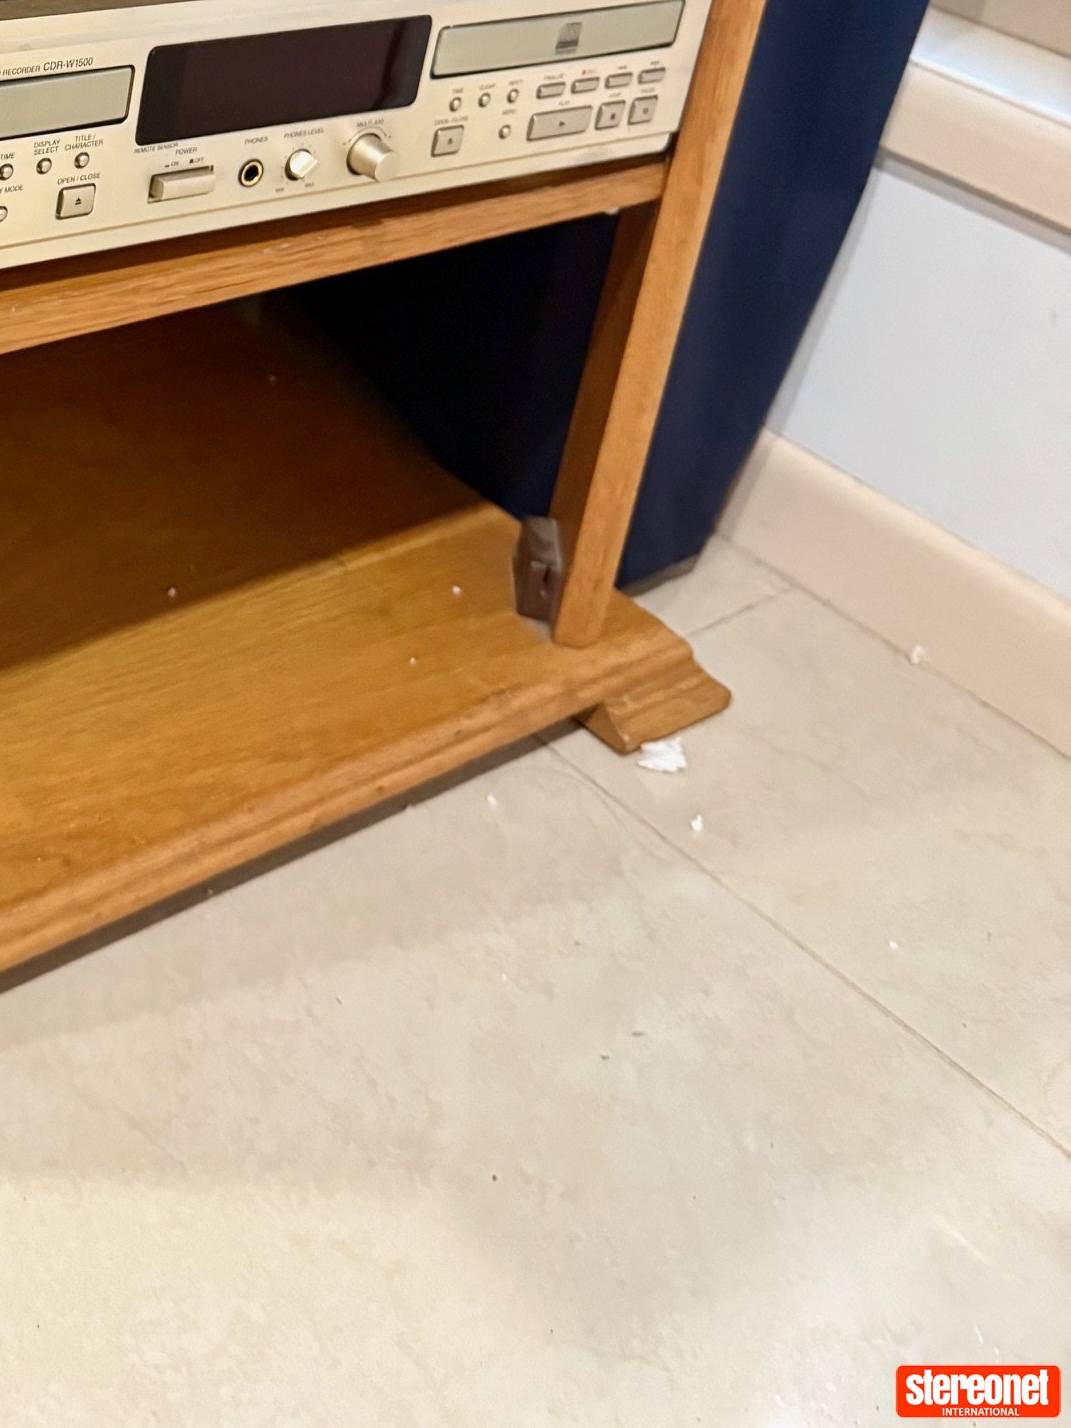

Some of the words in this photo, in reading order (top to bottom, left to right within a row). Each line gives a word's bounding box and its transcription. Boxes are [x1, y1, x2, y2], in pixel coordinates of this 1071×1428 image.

[3, 65, 41, 76] RECORDER
[75, 133, 92, 142] TITLE
[283, 131, 307, 139] PHONES
[307, 128, 325, 137] LEVEL
[33, 139, 61, 149] DISPLAY
[64, 139, 104, 151] CHARACTER
[244, 136, 269, 145] PHONES
[33, 145, 60, 155] SELECT
[133, 145, 156, 154] REMOTE
[157, 142, 179, 150] SENSOR
[174, 147, 198, 156] POWER
[0, 152, 15, 160] TIME
[57, 176, 76, 185] OPEN
[79, 172, 101, 181] CLOSE
[4, 184, 24, 194] MODE
